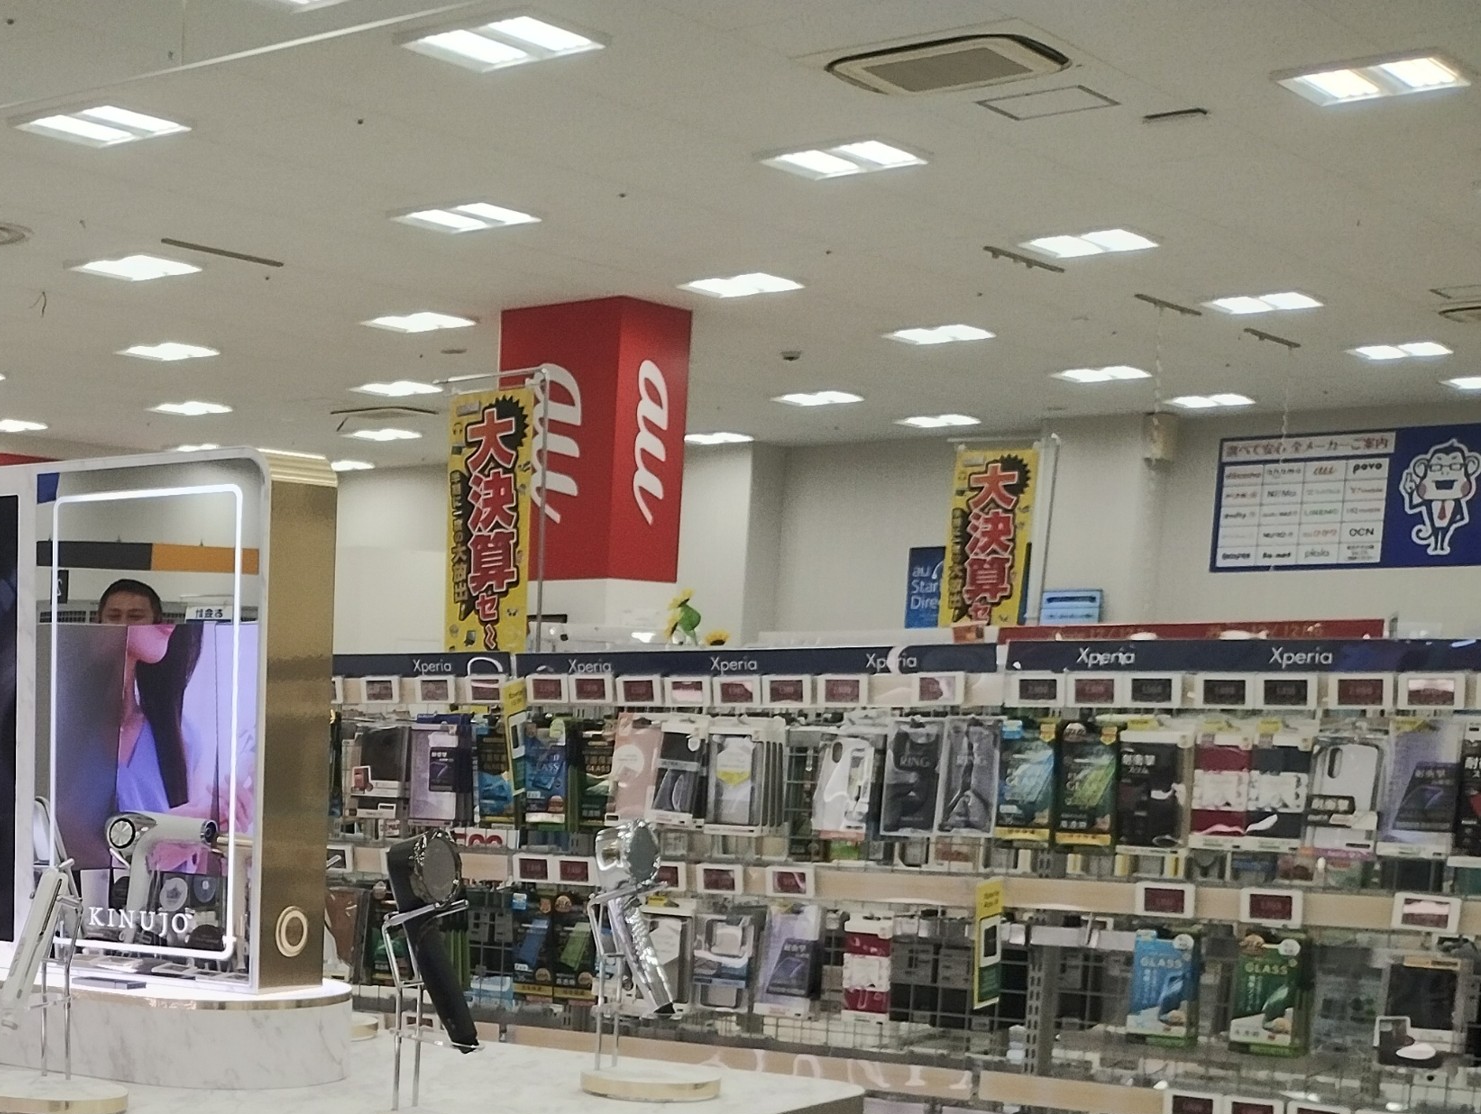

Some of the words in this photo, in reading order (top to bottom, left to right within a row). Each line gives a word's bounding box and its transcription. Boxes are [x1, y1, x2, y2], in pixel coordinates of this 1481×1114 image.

[524, 363, 582, 525] au
[633, 359, 669, 526] au
[1352, 461, 1383, 474] povo
[1349, 527, 1375, 537] OCN
[912, 566, 931, 577] au
[1076, 646, 1136, 667] Xperia
[1268, 646, 1334, 669] Xperia
[413, 659, 452, 674] Xperia
[568, 659, 612, 674] Xperia
[710, 656, 758, 676] Xperia
[88, 906, 193, 938] KINUJO
[1140, 957, 1184, 969] GLASS
[1245, 962, 1289, 975] GLASS
